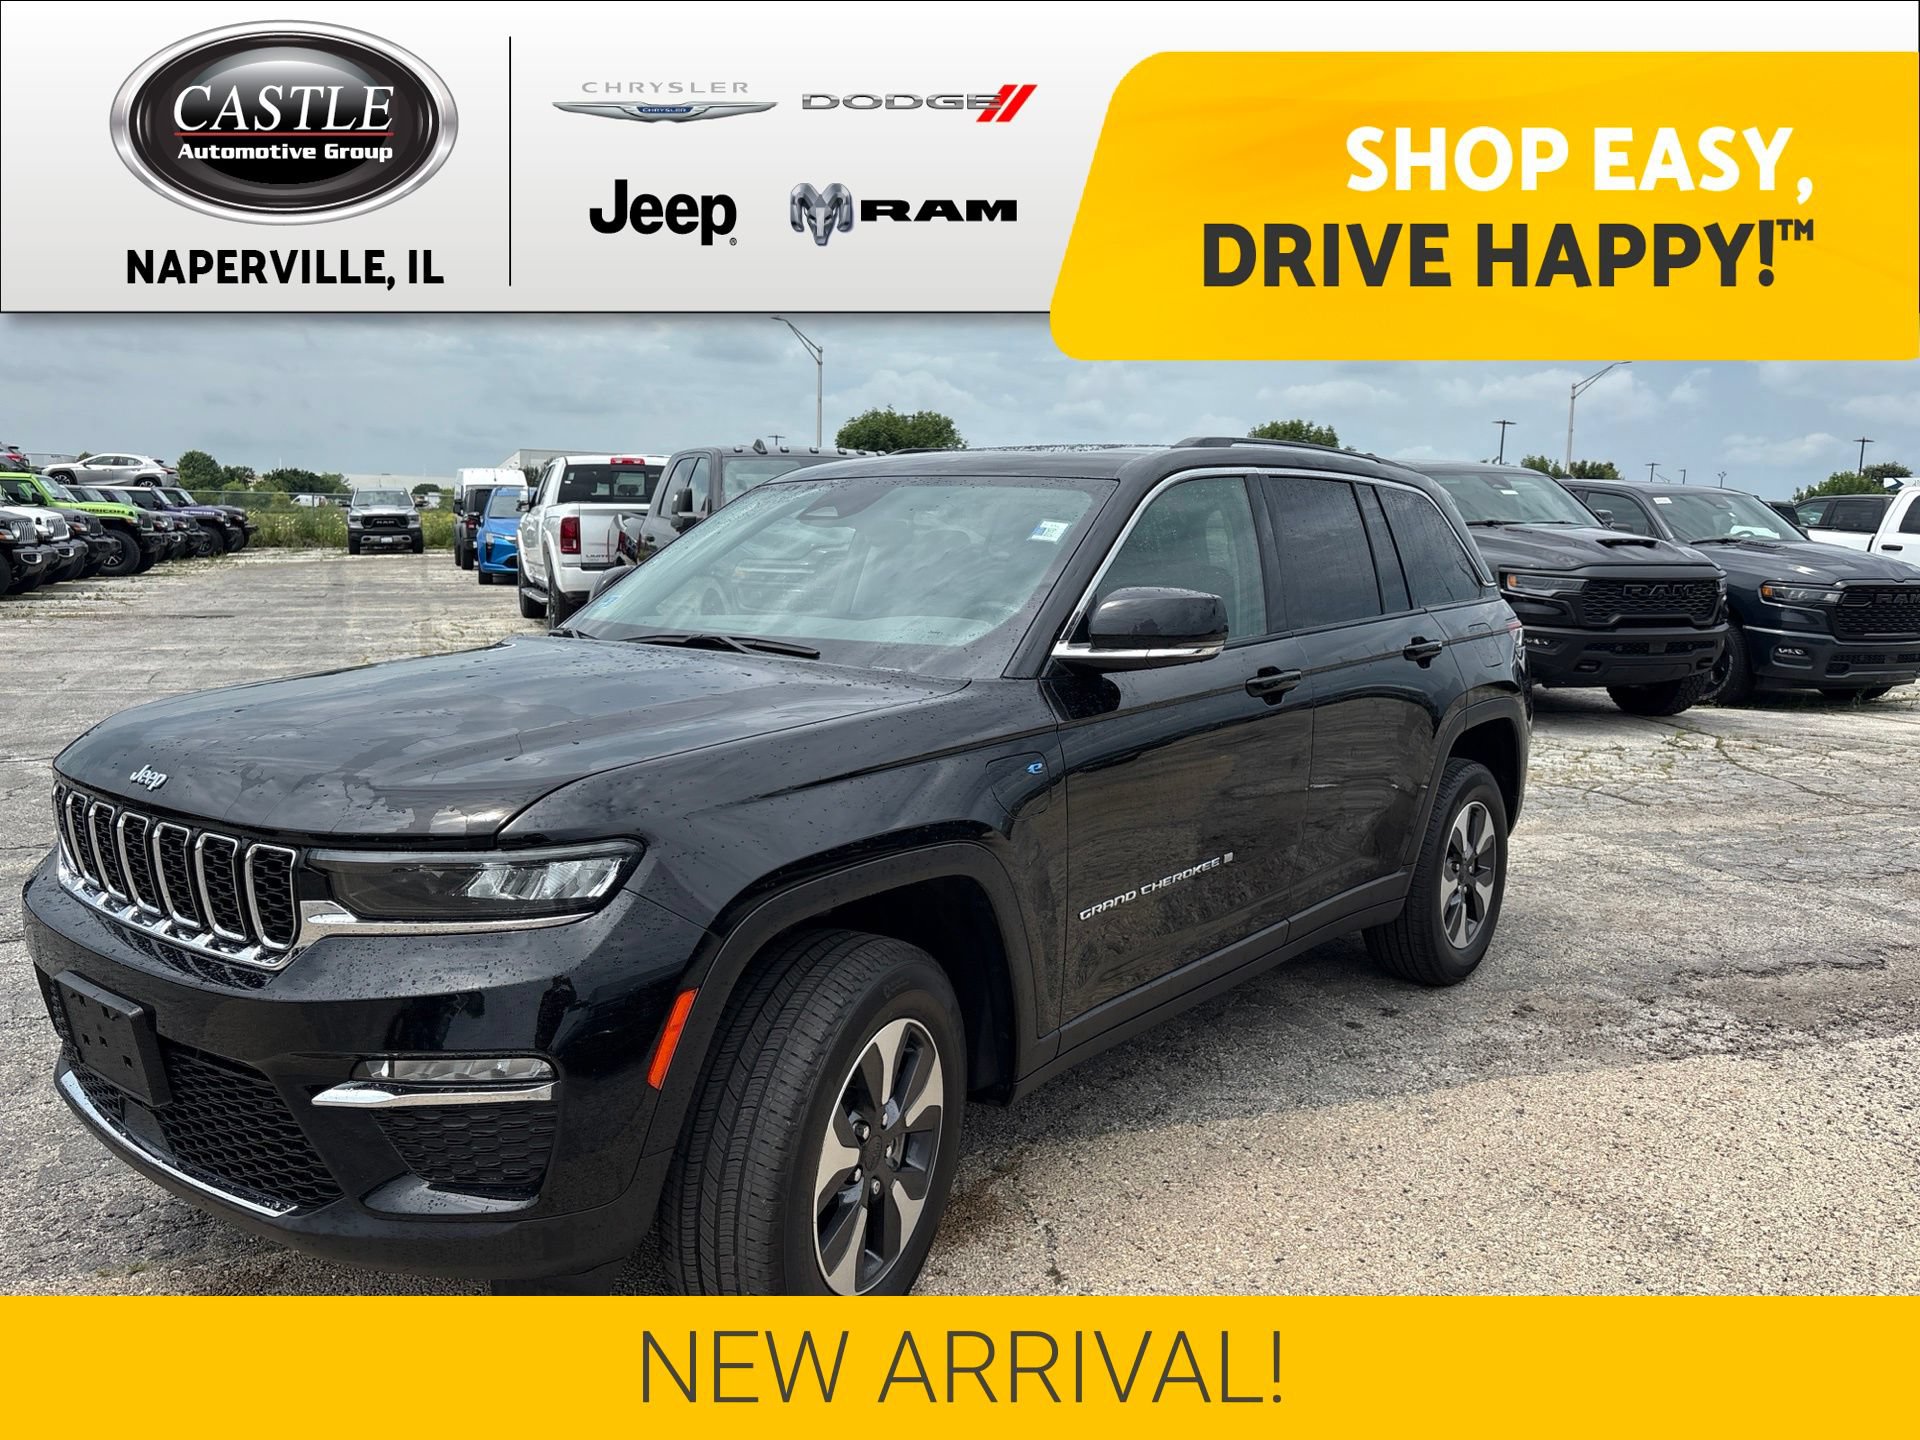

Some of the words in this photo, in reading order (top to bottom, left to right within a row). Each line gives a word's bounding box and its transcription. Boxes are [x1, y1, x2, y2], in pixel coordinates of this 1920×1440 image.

[1623, 583, 1695, 598] RAM
[129, 764, 168, 791] Jeep
[1079, 890, 1137, 921] GRAND
[1140, 856, 1220, 895] CHEROKEE
